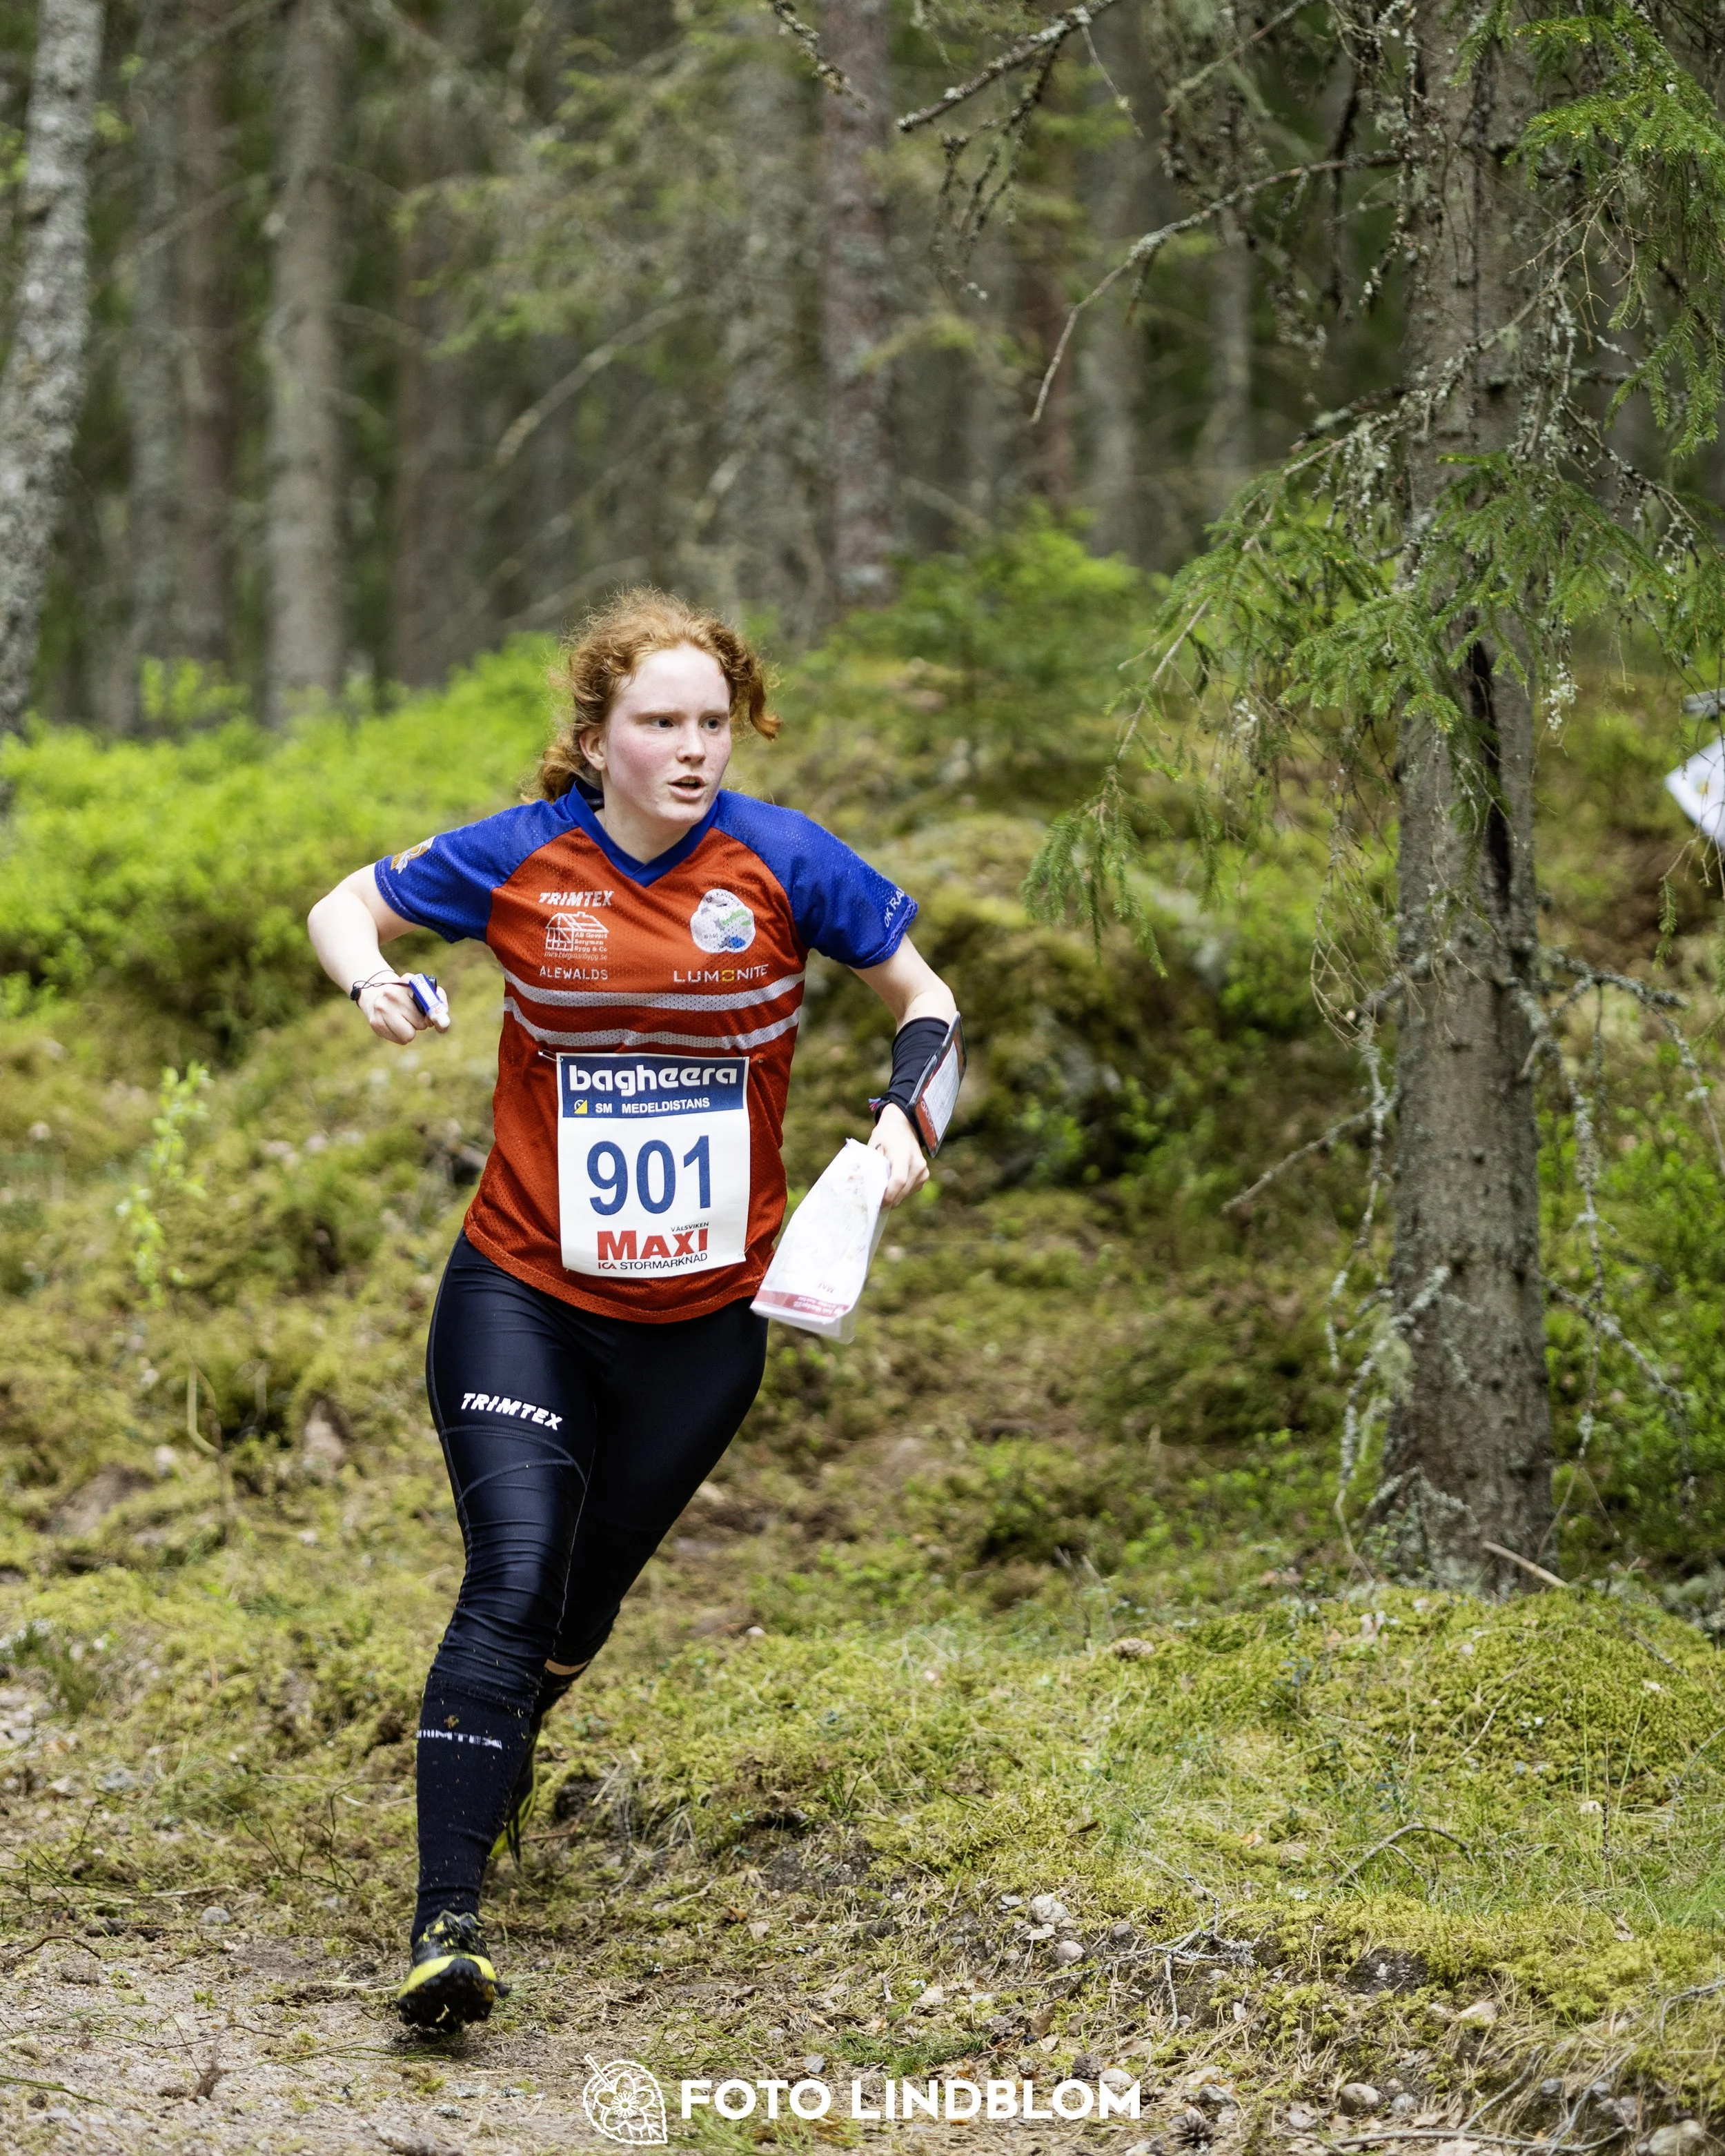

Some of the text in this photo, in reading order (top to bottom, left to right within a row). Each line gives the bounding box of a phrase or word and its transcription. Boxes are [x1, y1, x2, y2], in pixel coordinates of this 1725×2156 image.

[538, 890, 614, 907] TRIMTEX
[885, 907, 894, 928] OK
[540, 965, 608, 980] ALEWALDS
[673, 964, 769, 982] LUMONITE
[569, 1065, 738, 1097] bagheera
[595, 1097, 711, 1114] SM MEDELDISTANS
[586, 1134, 711, 1216] 901
[671, 1221, 709, 1232] VÄLSVIKEN
[597, 1227, 709, 1260] MAXI
[598, 1252, 708, 1270] ICA STORMARKNAD
[461, 1392, 563, 1431] TRIMTEX
